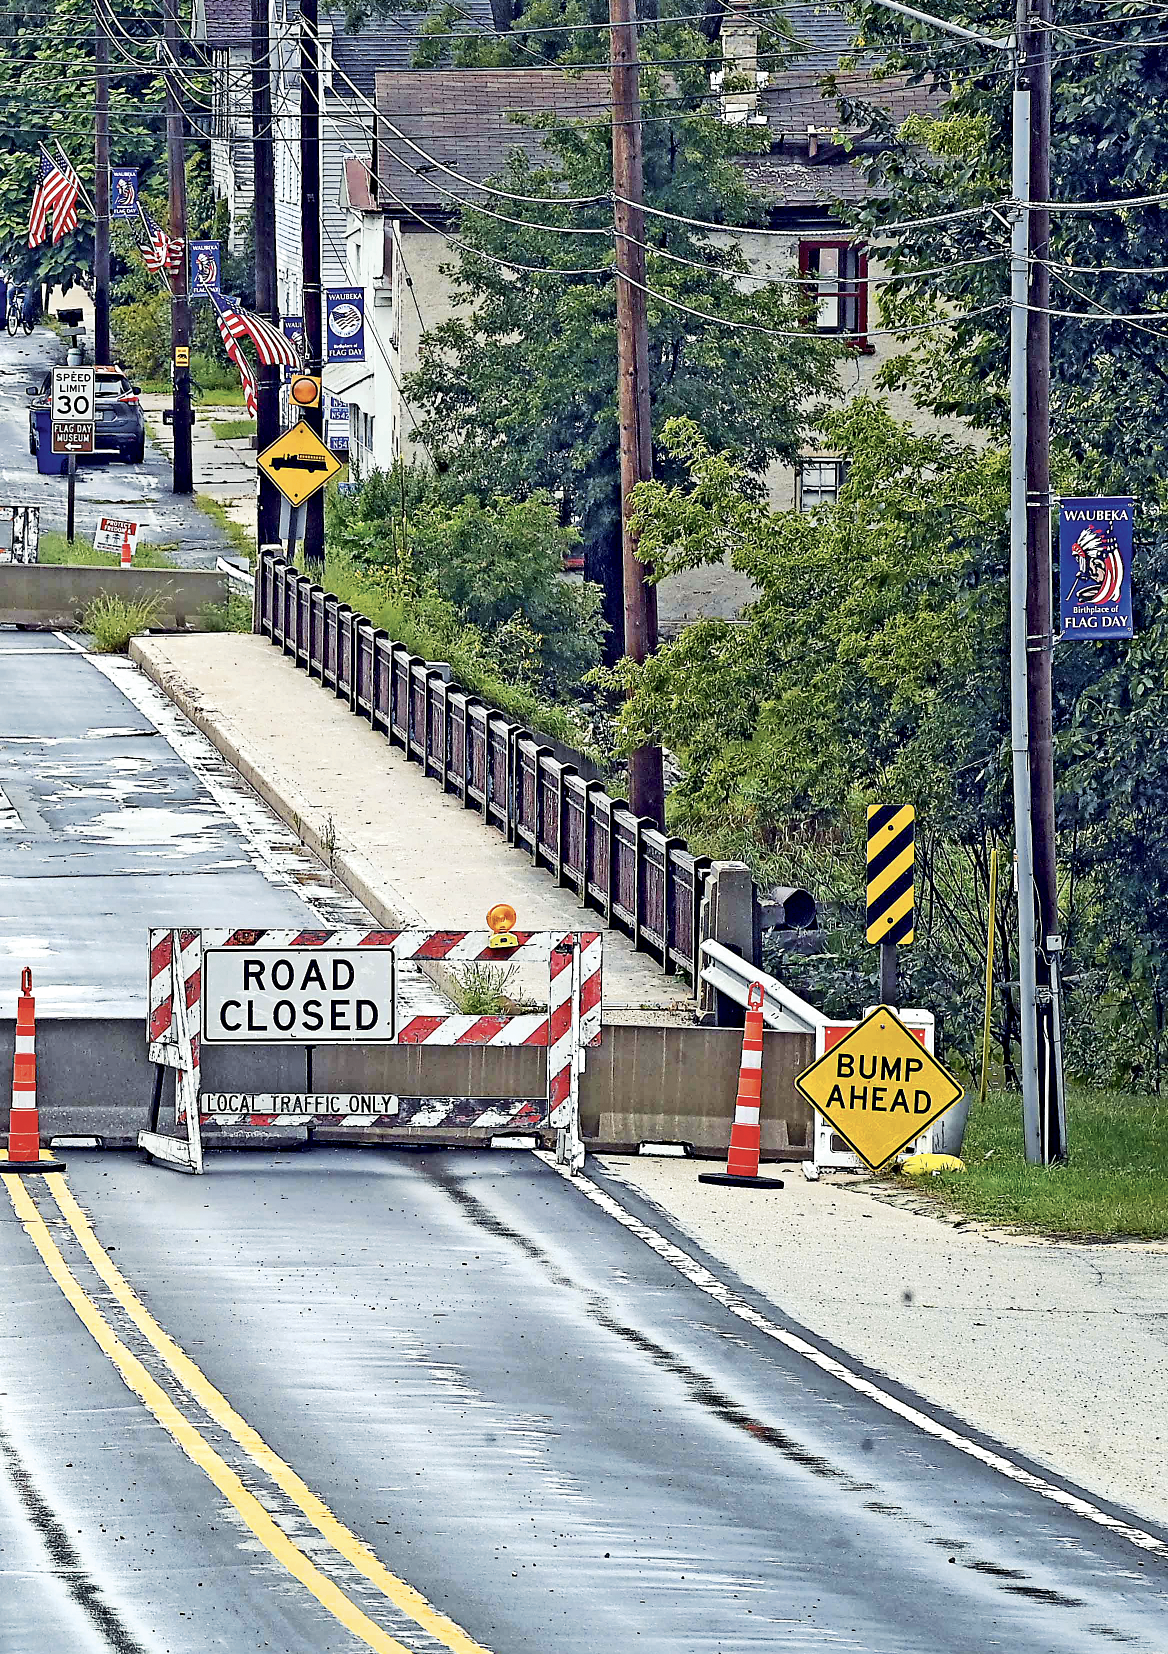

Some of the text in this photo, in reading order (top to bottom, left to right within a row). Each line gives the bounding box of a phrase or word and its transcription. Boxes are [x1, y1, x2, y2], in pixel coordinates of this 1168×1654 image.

[348, 348, 363, 356] DAY
[56, 373, 91, 382] SPEED
[59, 384, 87, 393] LIMIT
[57, 395, 89, 414] 30
[54, 424, 92, 433] FLAG DAY
[56, 433, 90, 442] MUSEUM
[1064, 509, 1129, 521] WAUBEKA
[1073, 604, 1119, 615] Birthplace of
[1065, 615, 1128, 628] FLAG DAY
[243, 958, 355, 991] ROAD
[219, 999, 379, 1031] CLOSED
[836, 1052, 924, 1082] BUMP
[207, 1094, 393, 1113] LOCAL TRAFFIC ONLY
[825, 1083, 932, 1114] AHEAD
